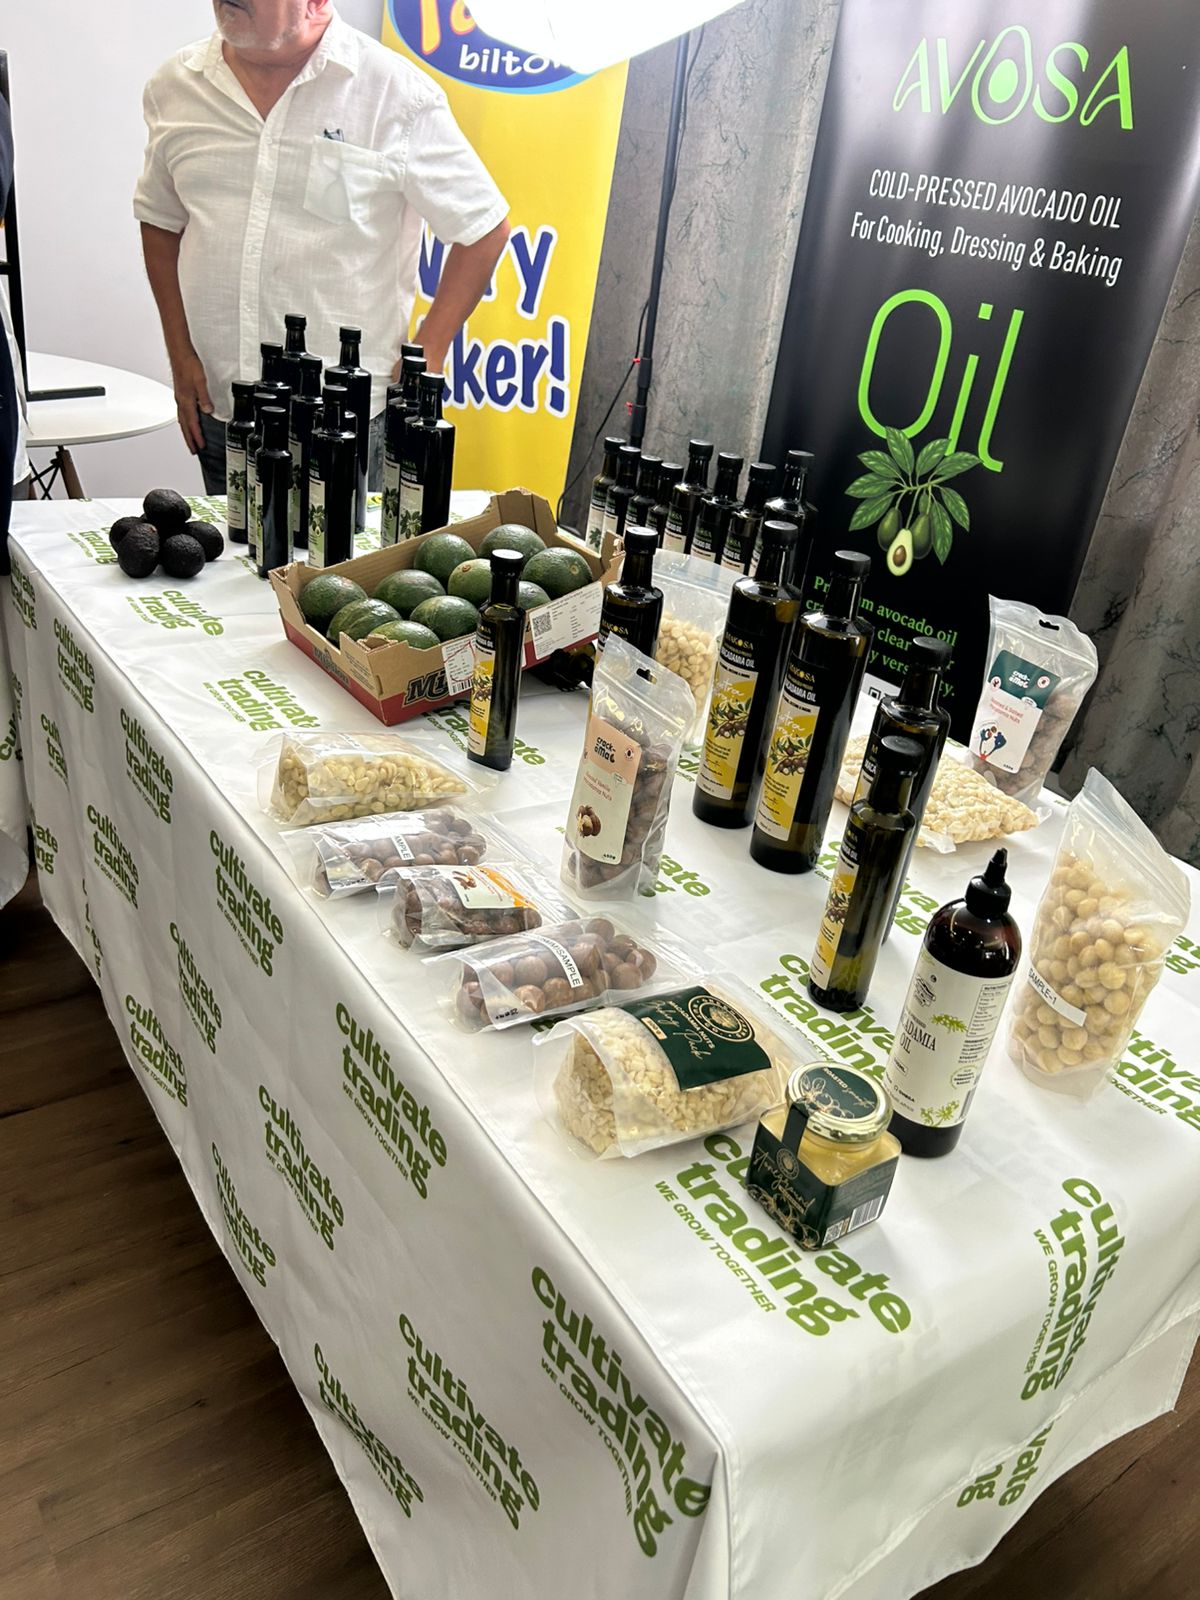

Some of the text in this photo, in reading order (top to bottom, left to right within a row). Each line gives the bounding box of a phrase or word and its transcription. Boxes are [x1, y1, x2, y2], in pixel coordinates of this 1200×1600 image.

[459, 44, 563, 76] bilto
[893, 25, 1134, 130] AVOSA
[850, 211, 1123, 287] For Cooking, Dressing & Baking
[869, 168, 1122, 229] COLD-PRESSED AVOCADO OIL
[858, 289, 1024, 473] Oil
[876, 604, 959, 647] avocado oil
[877, 628, 913, 652] clear
[119, 707, 174, 794] cultivate
[217, 678, 285, 732] trading
[124, 738, 172, 825] trading
[86, 803, 140, 887] cultivate
[93, 830, 138, 911] trading
[209, 829, 284, 945] cultivate
[215, 864, 274, 978] trading
[698, 1028, 716, 1050] NUTS
[1028, 966, 1058, 1006] SAMPLE-1
[129, 1020, 188, 1109] trading
[335, 1002, 447, 1167] cultivate
[822, 1066, 848, 1089] ROASTED
[898, 1038, 912, 1056] OIL
[258, 1084, 344, 1228] cultivate
[341, 1043, 433, 1201] trading
[373, 1127, 410, 1181] TOGETHER
[264, 1119, 336, 1252] trading
[655, 1180, 778, 1313] WE GROW TOGETHER
[675, 1161, 861, 1336] trading
[1023, 1229, 1059, 1375] WE GROW TOGETHER
[1061, 1177, 1126, 1390] cultivate
[1020, 1208, 1088, 1401] trading
[314, 1341, 424, 1504] cultivate
[398, 1312, 540, 1513] cultivate
[407, 1355, 525, 1531] trading
[407, 1387, 499, 1503] WE GROW TOGETHER
[531, 1265, 712, 1518] cultivate
[540, 1357, 633, 1518] WE GROW TOGETHER
[541, 1318, 674, 1558] trading
